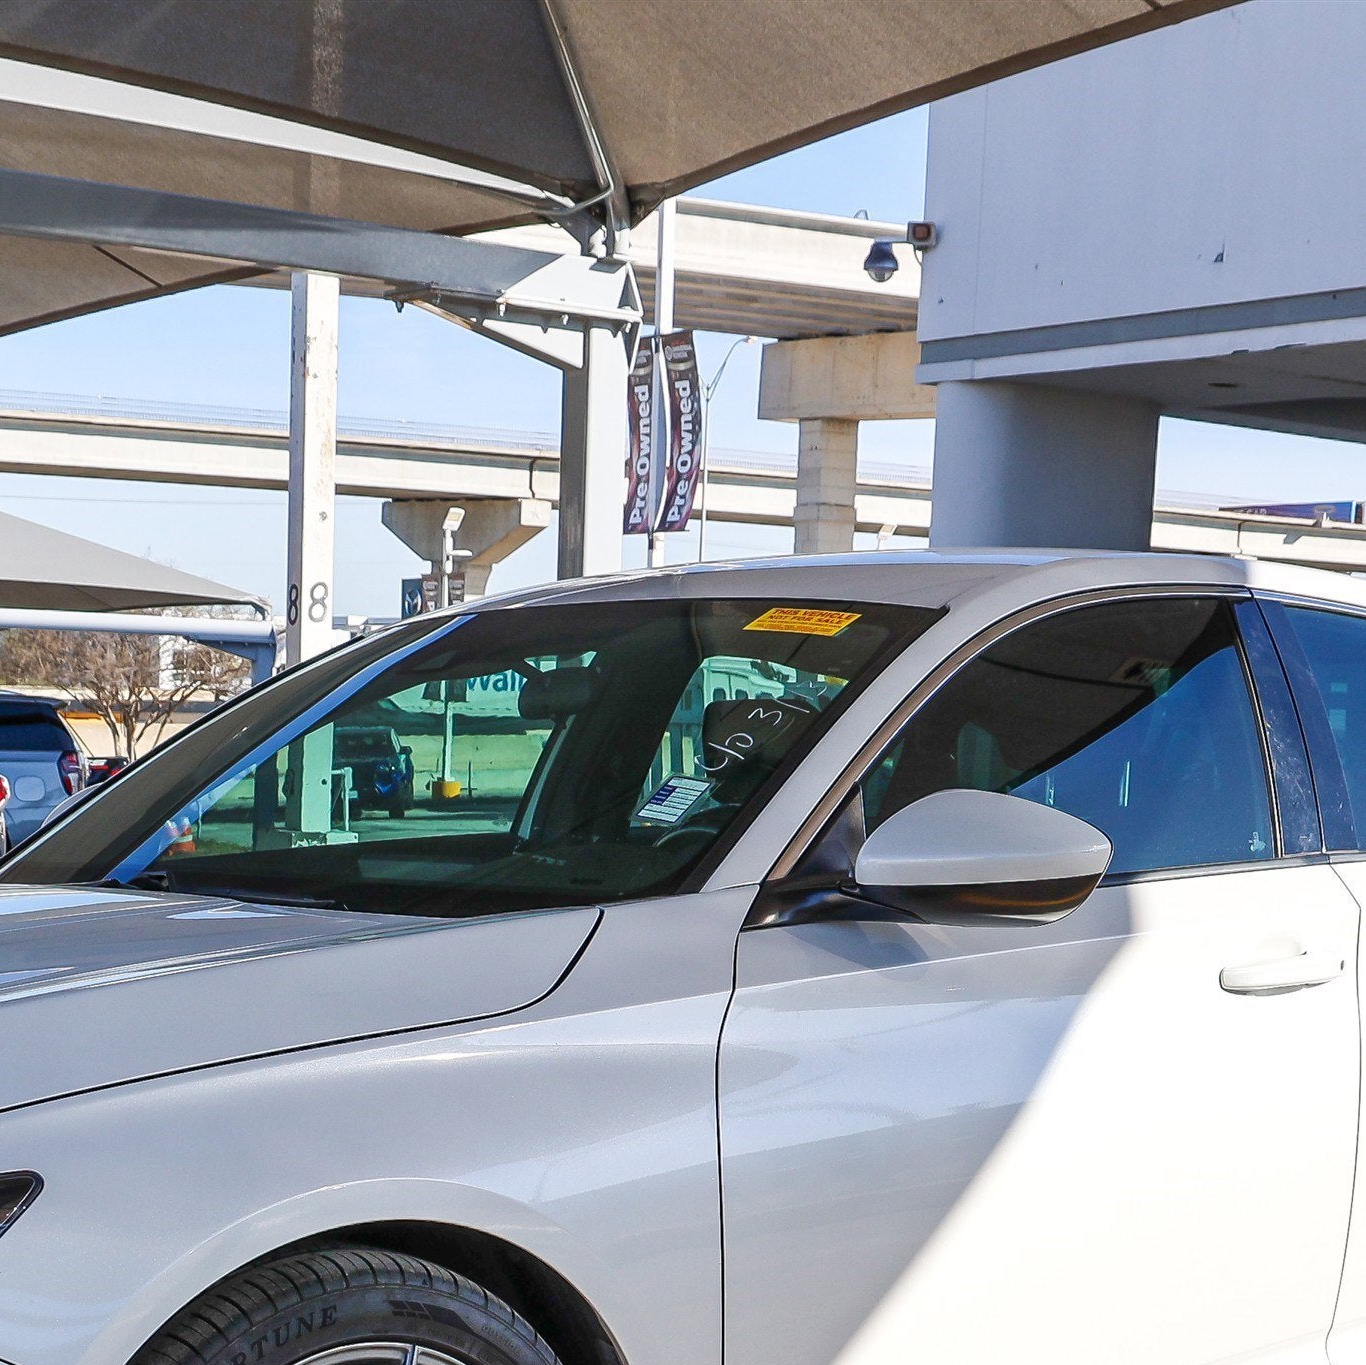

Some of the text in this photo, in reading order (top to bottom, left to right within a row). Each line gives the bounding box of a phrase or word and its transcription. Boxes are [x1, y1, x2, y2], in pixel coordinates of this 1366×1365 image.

[634, 384, 651, 476] Owned
[674, 379, 693, 474] Owned
[629, 482, 648, 525] Pre
[667, 479, 689, 523] Pre
[288, 583, 300, 626] 8
[308, 581, 329, 623] 8
[802, 609, 855, 621] VEHICLE
[816, 617, 844, 625] SALE
